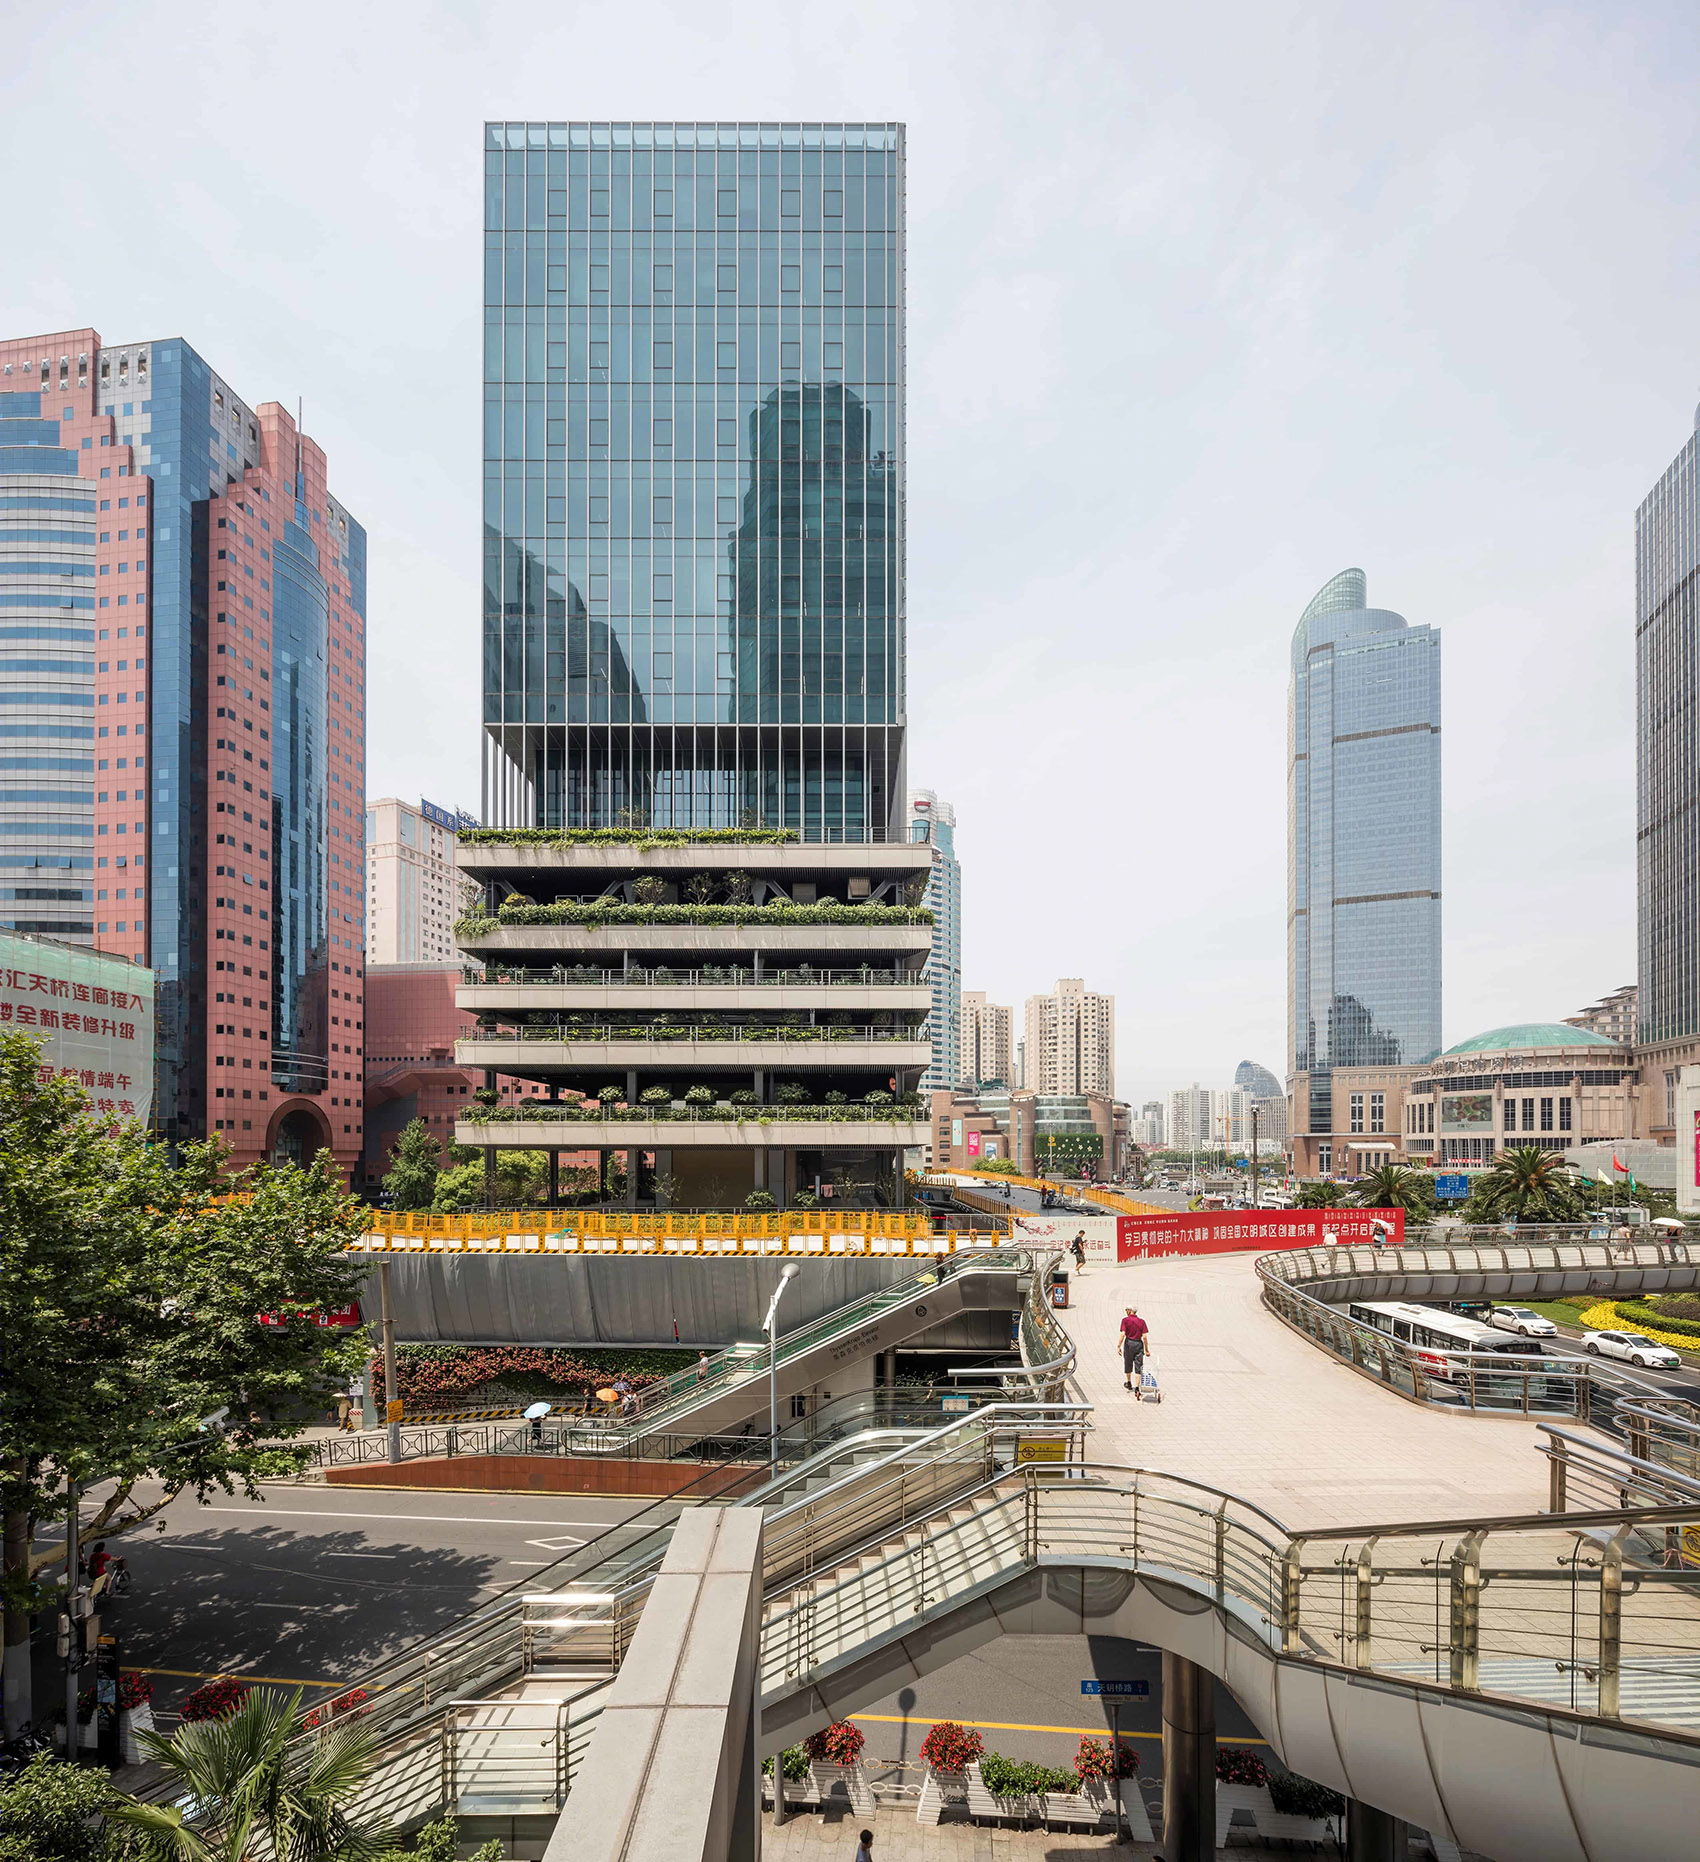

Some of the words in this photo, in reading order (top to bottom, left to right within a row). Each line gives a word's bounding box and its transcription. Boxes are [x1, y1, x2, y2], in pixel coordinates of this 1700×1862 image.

[0, 969, 144, 1013] 汇天桥连廊接入
[1124, 1227, 1208, 1247] 学习贯彻党的十九大精神
[1322, 1222, 1395, 1237] 新起点开启新程
[1097, 1683, 1132, 1693] 天钥桥路
